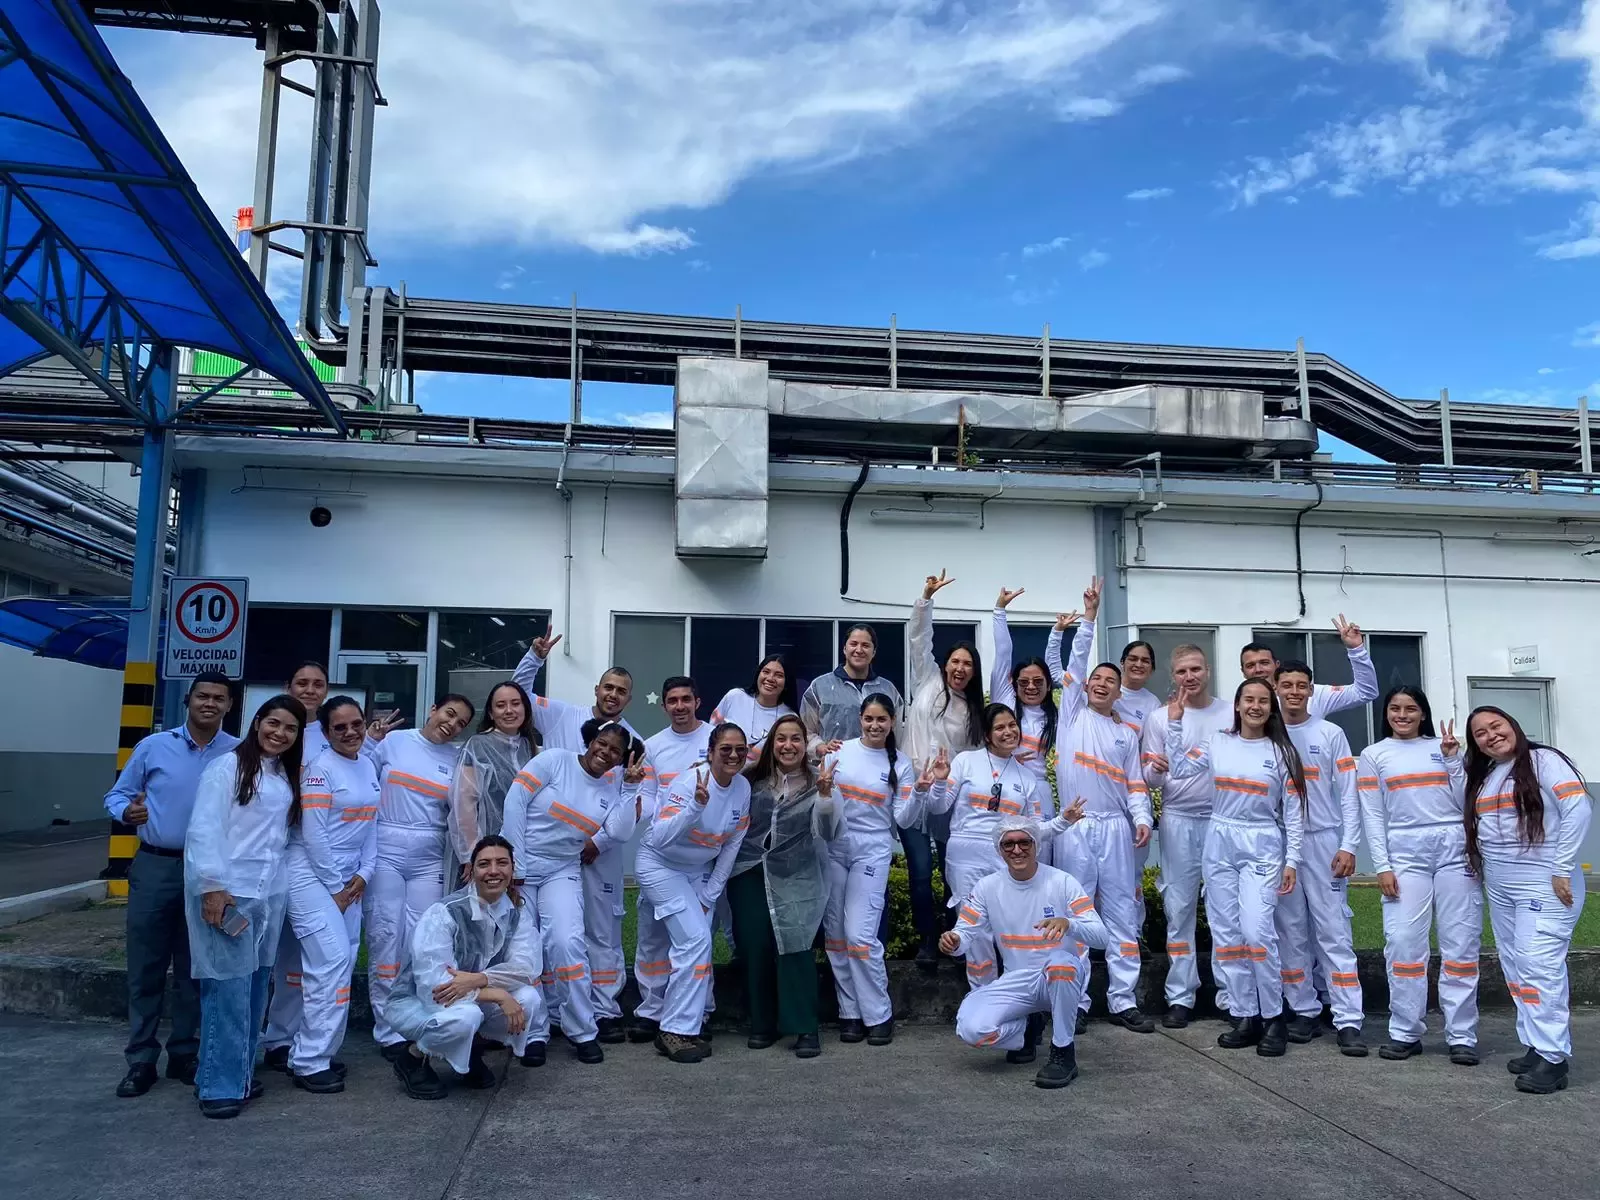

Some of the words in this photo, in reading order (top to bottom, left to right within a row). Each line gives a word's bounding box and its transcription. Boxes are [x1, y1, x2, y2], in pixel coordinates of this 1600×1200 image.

[189, 594, 226, 622] 10
[195, 625, 217, 634] Km/h
[173, 648, 237, 660] VELOCIDAD
[1513, 655, 1536, 665] Calidad
[180, 660, 227, 674] MÁXIMA
